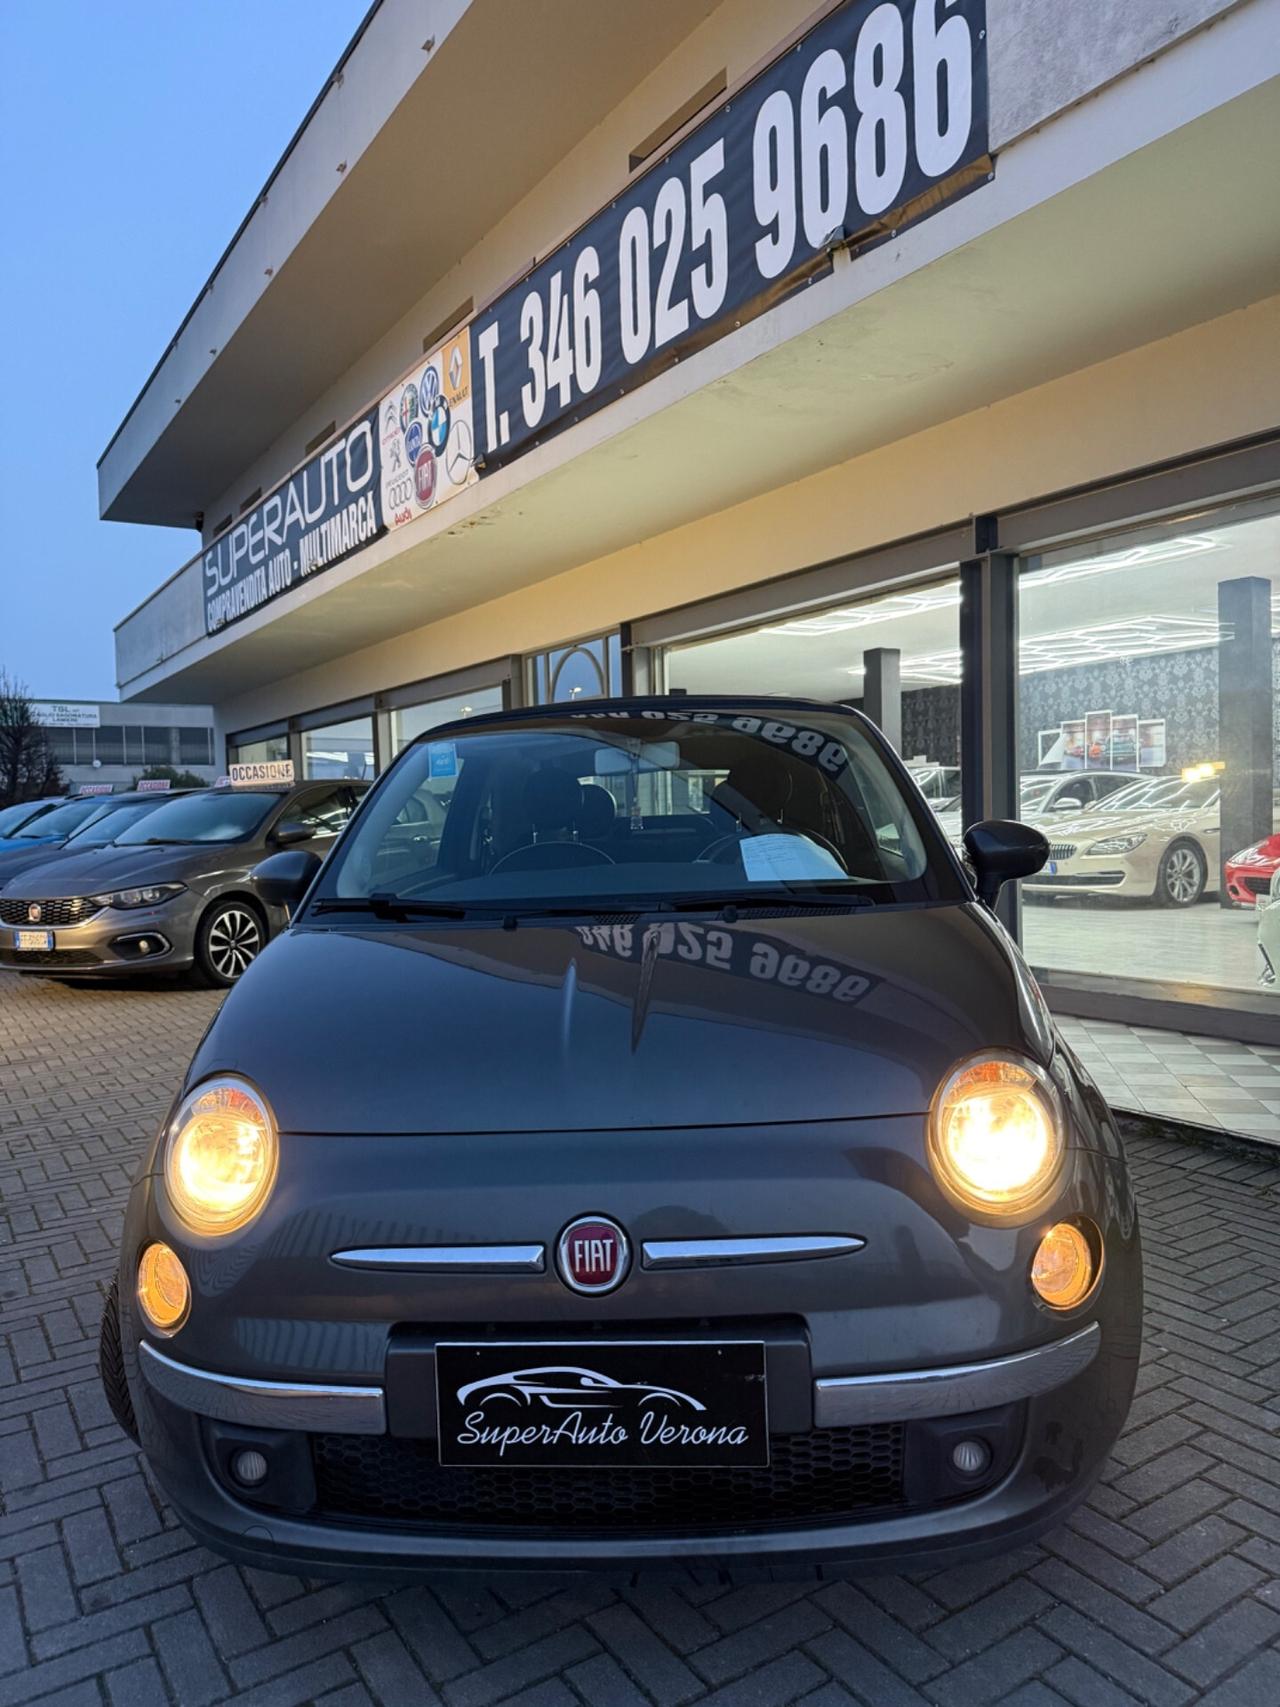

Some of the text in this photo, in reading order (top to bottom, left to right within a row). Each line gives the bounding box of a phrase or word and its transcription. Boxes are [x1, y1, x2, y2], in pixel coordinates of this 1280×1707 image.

[479, 0, 973, 453] T. 346 025 9686
[417, 459, 433, 490] FIAT
[204, 419, 373, 597] SUPERAUTO
[395, 507, 412, 525] Audi
[207, 565, 269, 633] COMPRAVENDITA
[268, 548, 292, 596] AUTO
[300, 491, 378, 578] MULTIMARCA
[232, 763, 292, 781] OCCASIONE
[573, 1238, 614, 1273] FIAT
[457, 1410, 750, 1457] SuperAuto Verona
